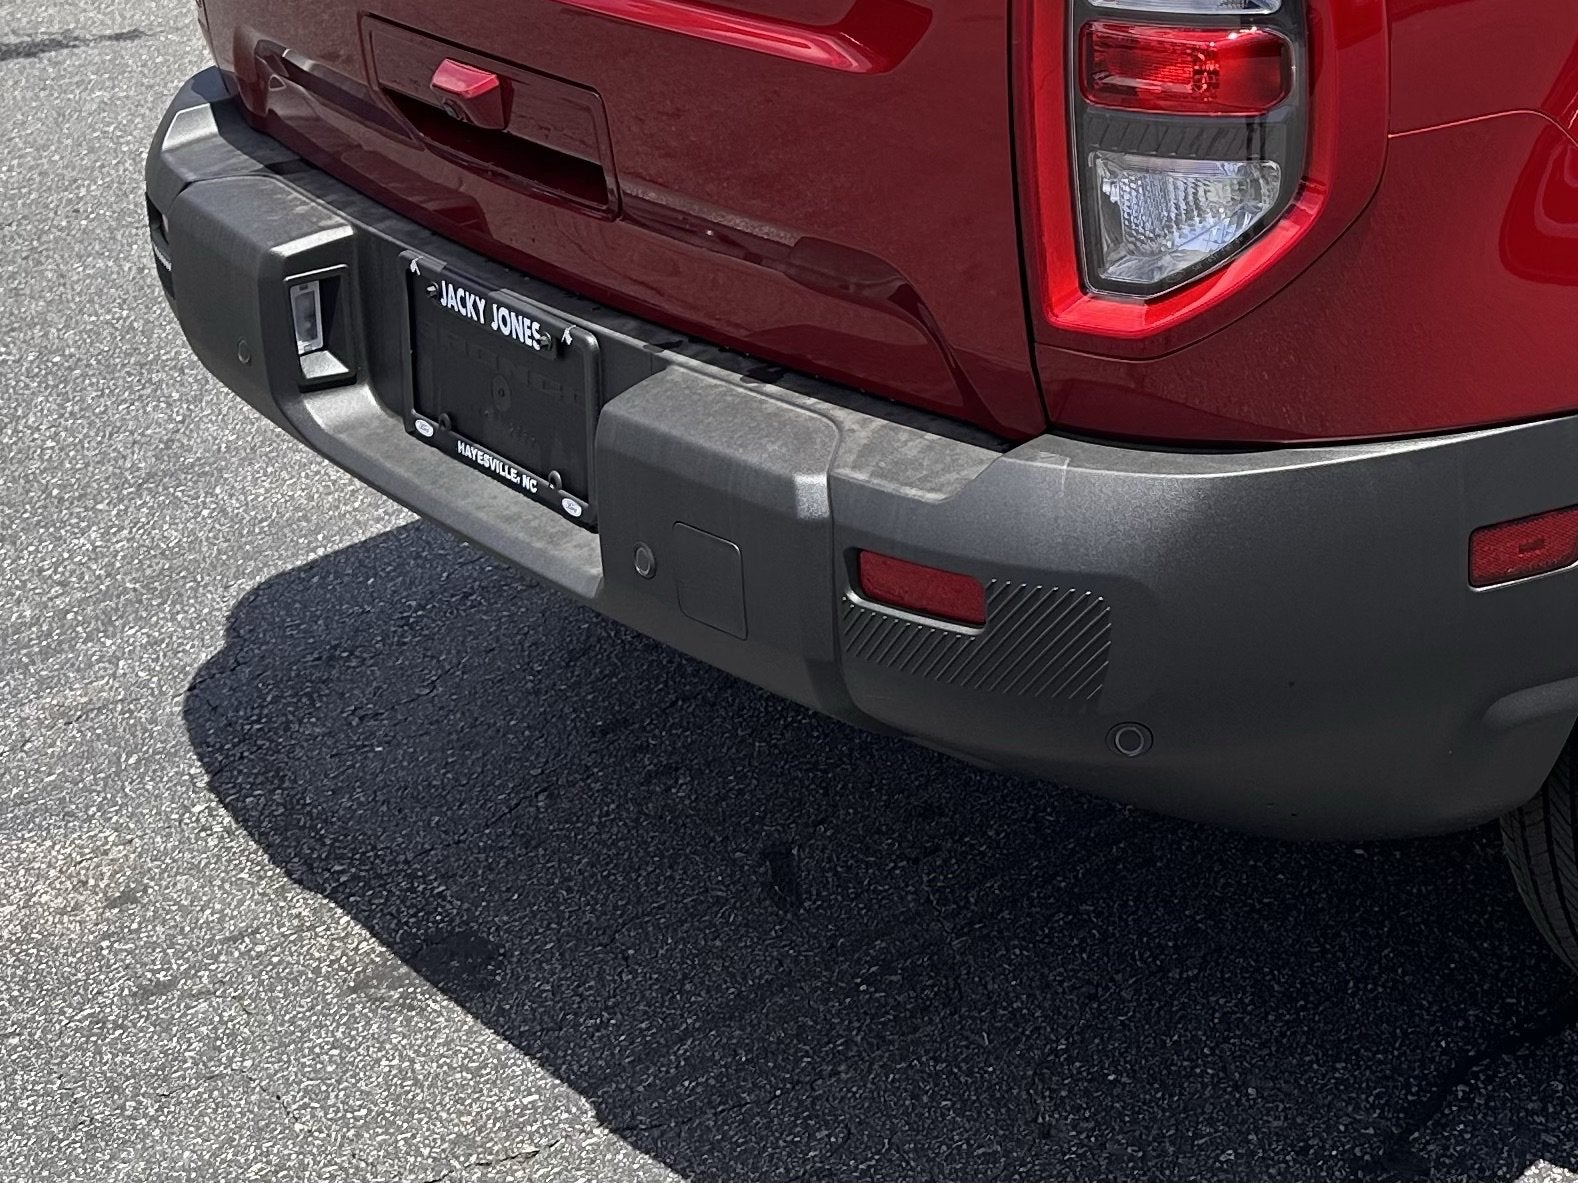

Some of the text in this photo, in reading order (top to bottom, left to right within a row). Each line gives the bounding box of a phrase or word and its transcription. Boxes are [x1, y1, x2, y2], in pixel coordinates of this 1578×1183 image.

[440, 280, 541, 351] JACKY JONES
[457, 440, 538, 494] HAYESVILLE, NC
